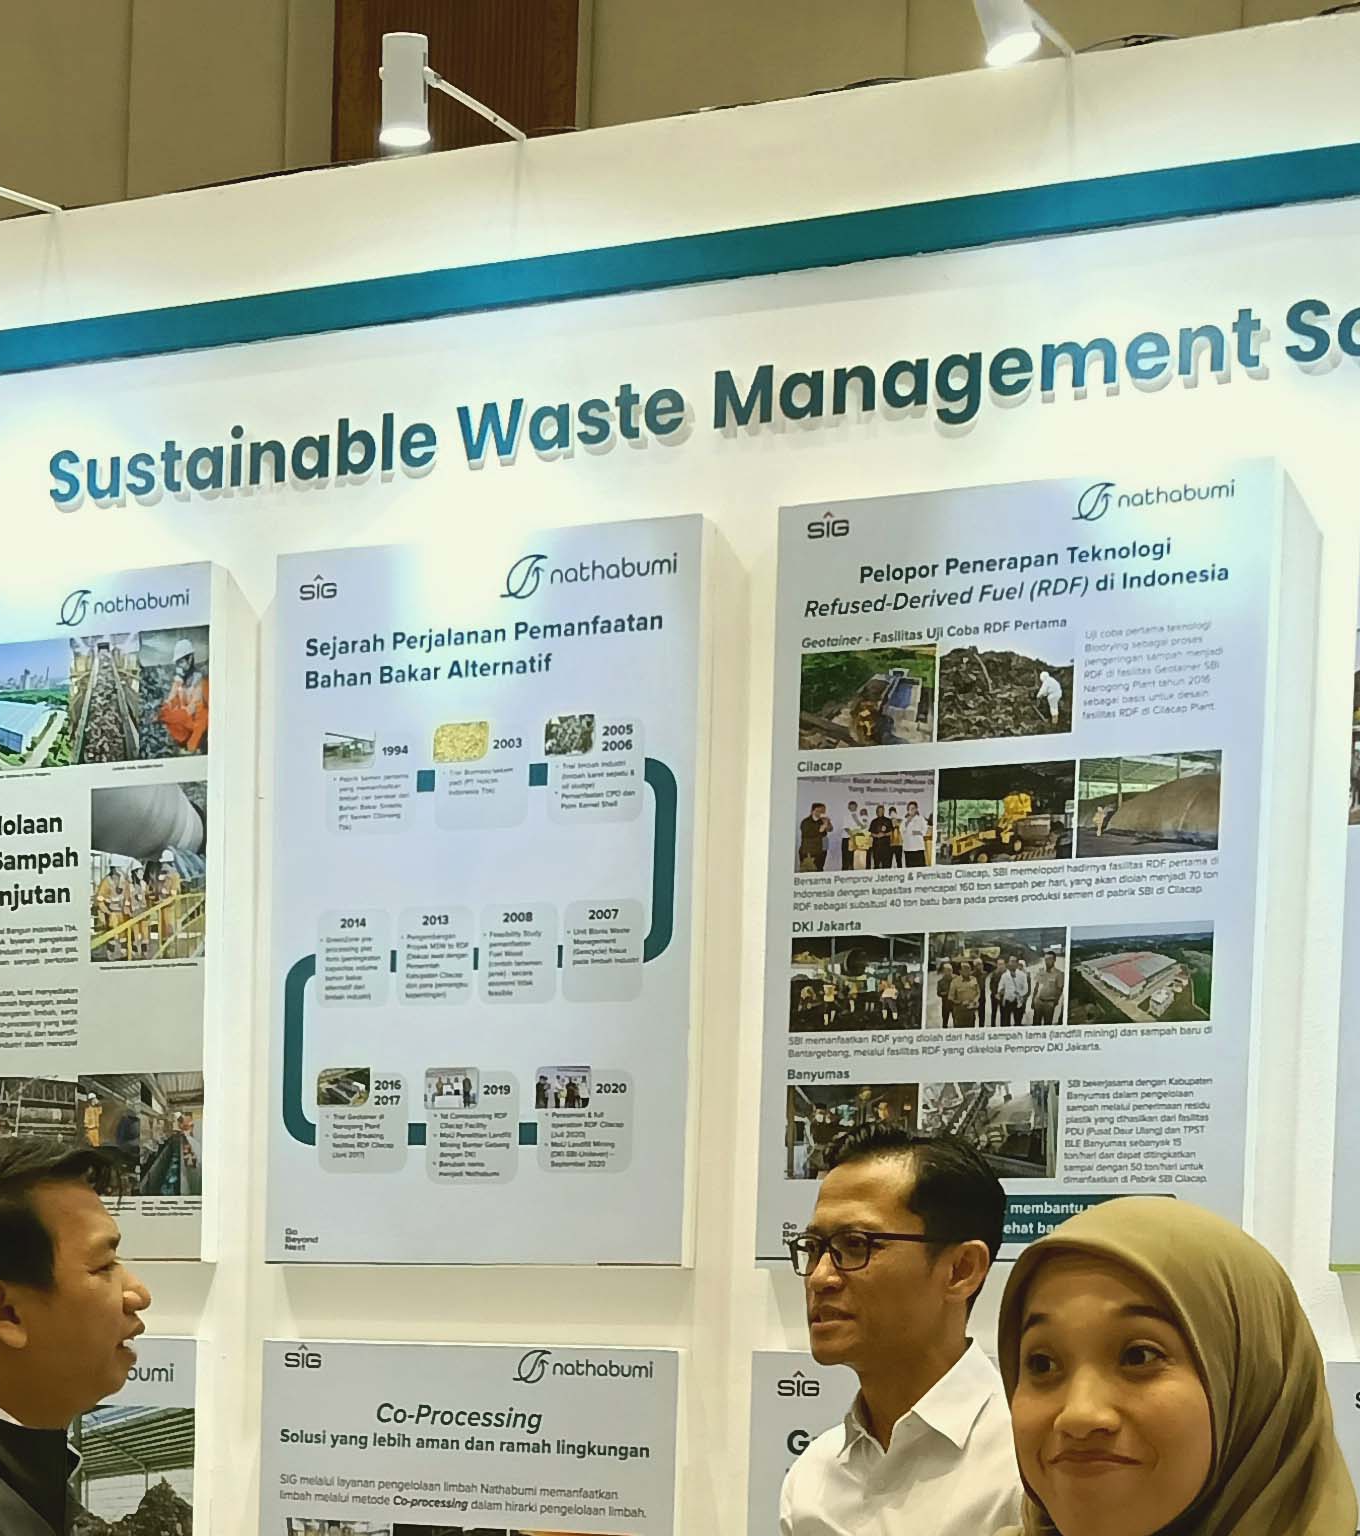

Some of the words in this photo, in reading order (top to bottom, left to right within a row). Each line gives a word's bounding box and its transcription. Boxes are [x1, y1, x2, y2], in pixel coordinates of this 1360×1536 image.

[49, 414, 437, 507] Sustainable
[455, 382, 686, 462] Waste
[713, 307, 1265, 434] Management
[1118, 479, 1235, 509] nathabumi
[808, 512, 849, 539] SIG
[550, 553, 678, 585] nathabumi
[860, 560, 939, 586] Pelopor
[946, 550, 1059, 577] Penerapan
[1067, 538, 1172, 563] Teknologi
[299, 574, 337, 600] SIG
[804, 586, 973, 618] Refused-Derived
[979, 581, 1024, 603] Fuel
[1030, 576, 1089, 602] (RDF)
[1095, 573, 1115, 593] di
[1121, 565, 1230, 591] Indonesia
[94, 589, 190, 615] nathabumi
[306, 634, 385, 659] Sejarah
[393, 628, 506, 653] Perjalanan
[514, 614, 663, 640] Pemanfaatan
[305, 669, 372, 689] Bahan
[380, 664, 441, 684] Bakar
[448, 654, 552, 679] Alternatif
[602, 725, 633, 737] 2005
[382, 745, 408, 756] 1994
[493, 738, 522, 750] 2003
[601, 740, 633, 752] 2006
[797, 760, 842, 774] Cilacap
[422, 915, 449, 925] 2013
[503, 912, 533, 923] 2008
[588, 909, 619, 920] 2007
[340, 918, 366, 928] 2014
[792, 920, 814, 933] DKI
[817, 920, 862, 932] Jakarta
[787, 1068, 850, 1081] Banyumas
[374, 1080, 402, 1091] 2016
[483, 1085, 510, 1095] 2019
[596, 1083, 627, 1094] 2020
[374, 1095, 400, 1106] 2017
[1010, 1202, 1084, 1214] membantu
[284, 1344, 321, 1369] SIG
[552, 1360, 653, 1378] nathabumi
[777, 1371, 820, 1396] SIG
[376, 1402, 542, 1434] Co-Processing
[280, 1428, 327, 1445] Solusi
[330, 1433, 368, 1449] yang
[372, 1432, 411, 1449] lebih
[415, 1437, 460, 1452] aman
[464, 1436, 495, 1453] dan
[499, 1438, 552, 1455] ramah
[556, 1438, 650, 1461] lingkungan
